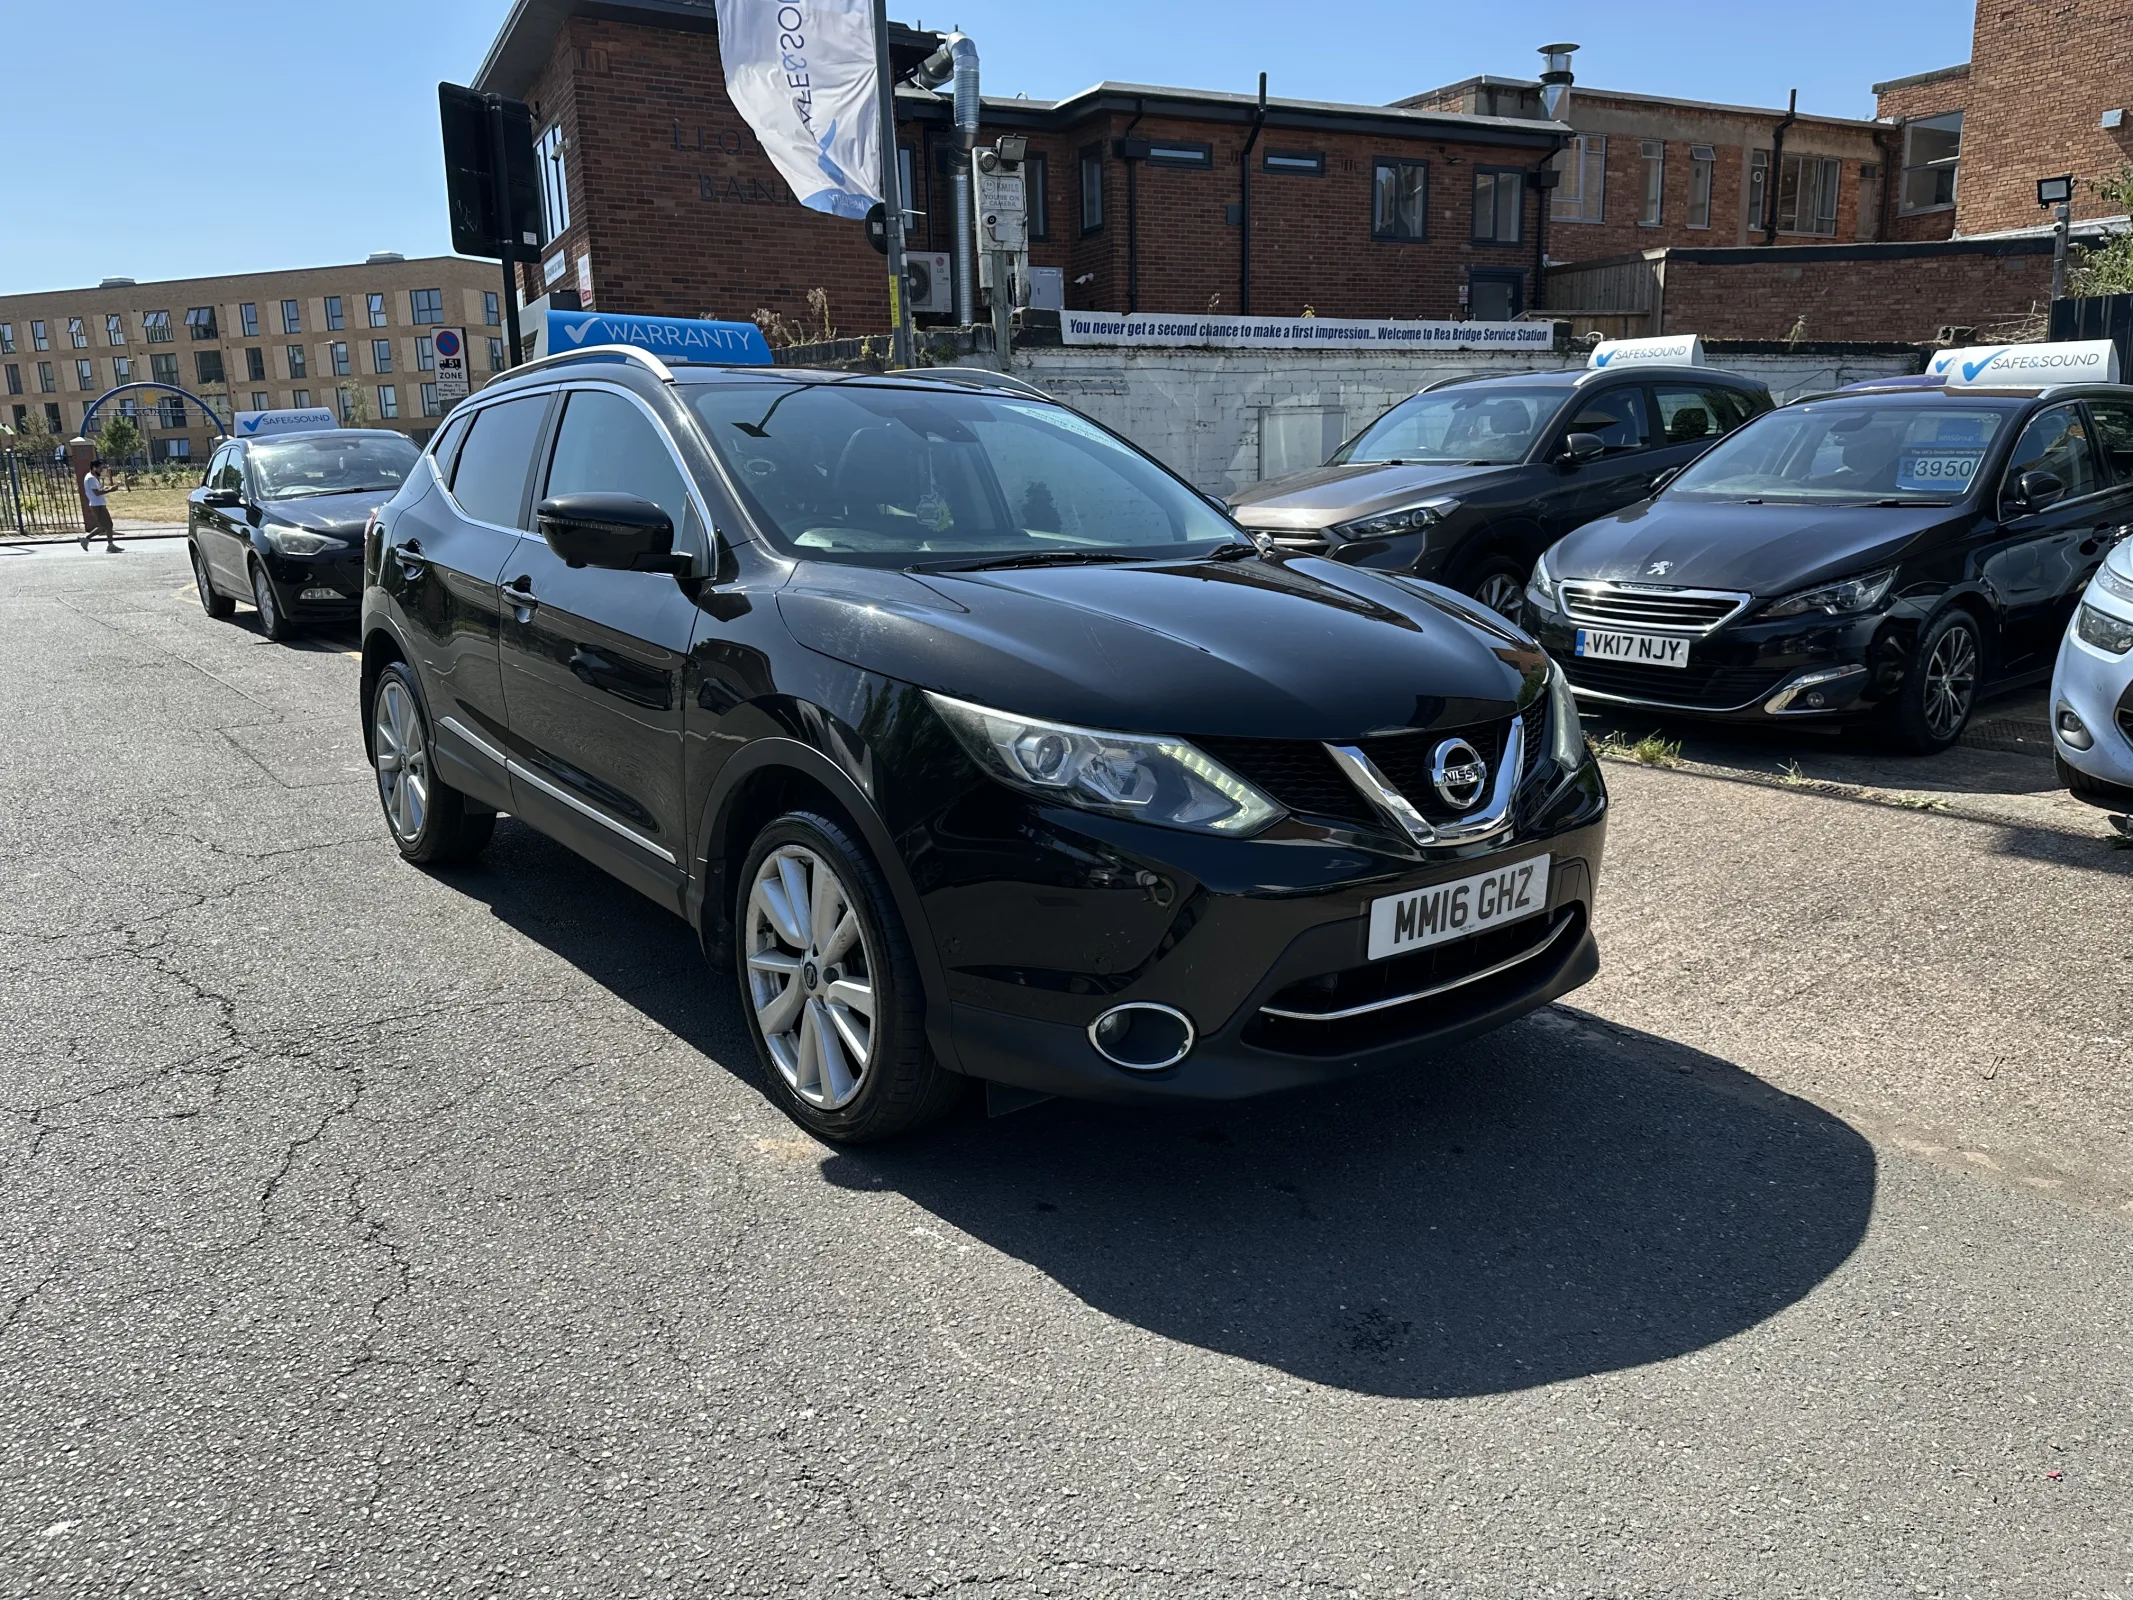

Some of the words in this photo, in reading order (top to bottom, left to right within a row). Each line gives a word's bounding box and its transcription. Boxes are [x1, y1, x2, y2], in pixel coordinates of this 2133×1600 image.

[602, 321, 750, 350] WARRANTY
[1070, 319, 1091, 334] You
[1093, 321, 1125, 335] never
[1127, 322, 1146, 337] get
[1148, 324, 1155, 336] a
[1158, 322, 1198, 337] second
[1199, 323, 1239, 337] chance
[1241, 325, 1251, 338] to
[1253, 325, 1282, 338] make
[1284, 327, 1290, 338] a
[1292, 325, 1314, 339] first
[1315, 325, 1376, 340] impression...
[1378, 327, 1421, 340] Welcome
[1423, 328, 1432, 340] to
[1434, 328, 1451, 341] Rea
[1452, 328, 1482, 342] Bridge
[1483, 328, 1515, 341] Service
[1517, 329, 1548, 342] Station
[1616, 345, 1687, 360] SAFE&SOUND
[1991, 353, 2100, 370] SAFE&SOUND
[262, 413, 330, 426] SAFE&SOUND
[1593, 633, 1634, 656] VK17
[1638, 637, 1681, 661] NJY
[1393, 884, 1470, 944] MM16
[1477, 864, 1534, 920] GHZ
